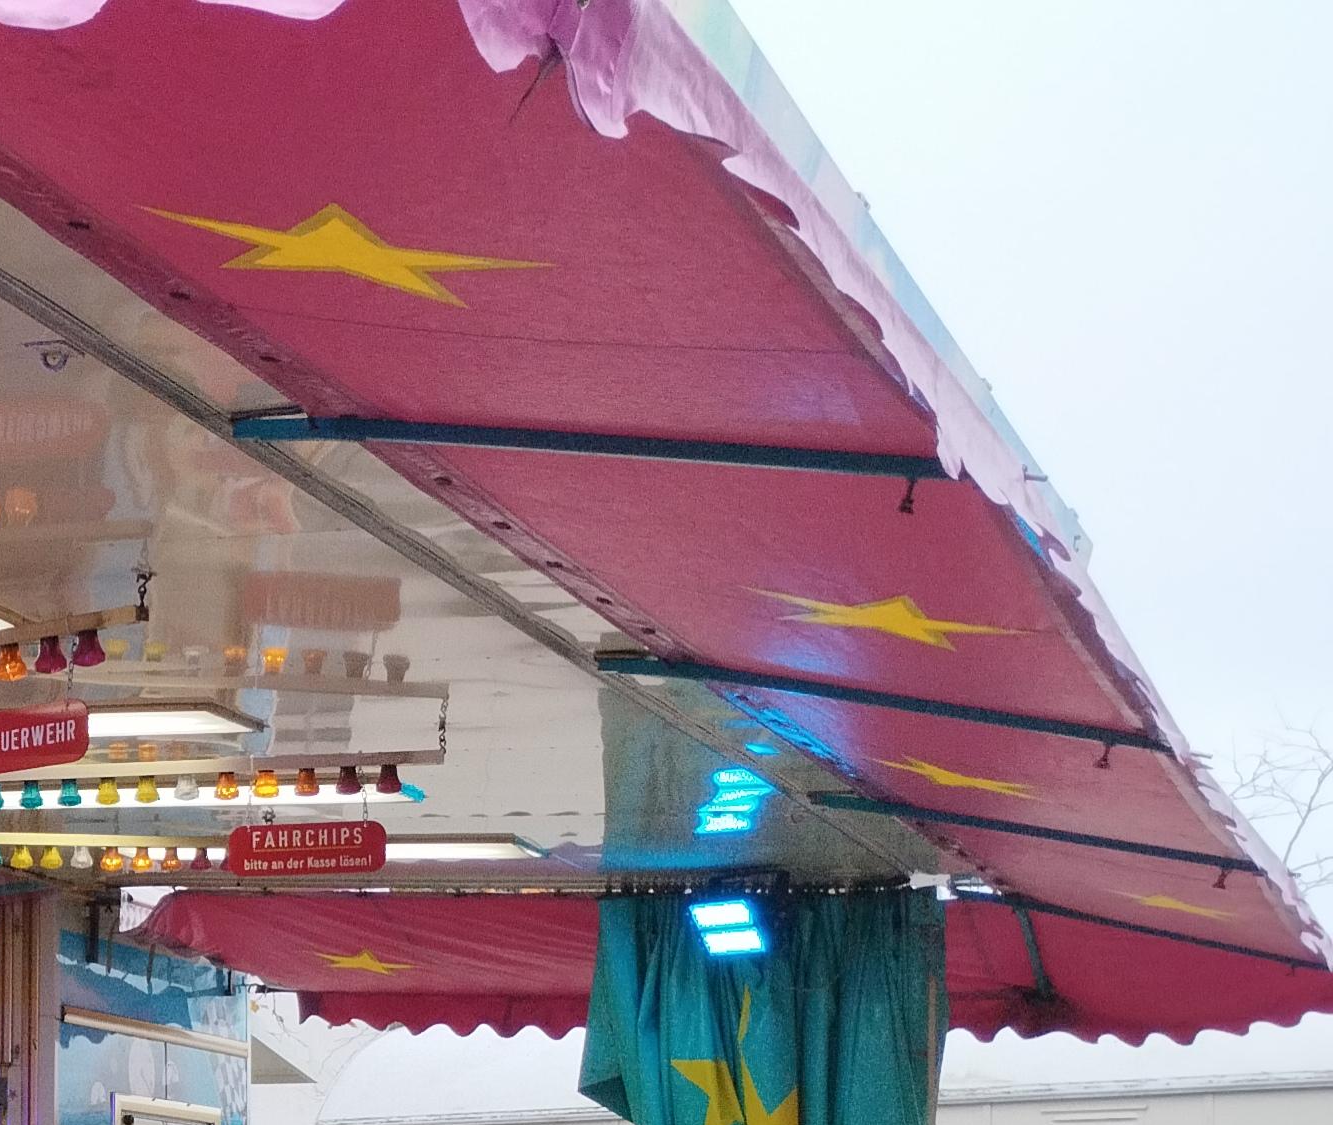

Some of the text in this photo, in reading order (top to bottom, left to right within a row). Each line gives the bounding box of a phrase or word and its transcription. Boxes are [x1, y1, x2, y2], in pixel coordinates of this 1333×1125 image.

[252, 827, 363, 849] FAHRCHIPS
[244, 854, 372, 871] bitte an der Kasse lösen!
